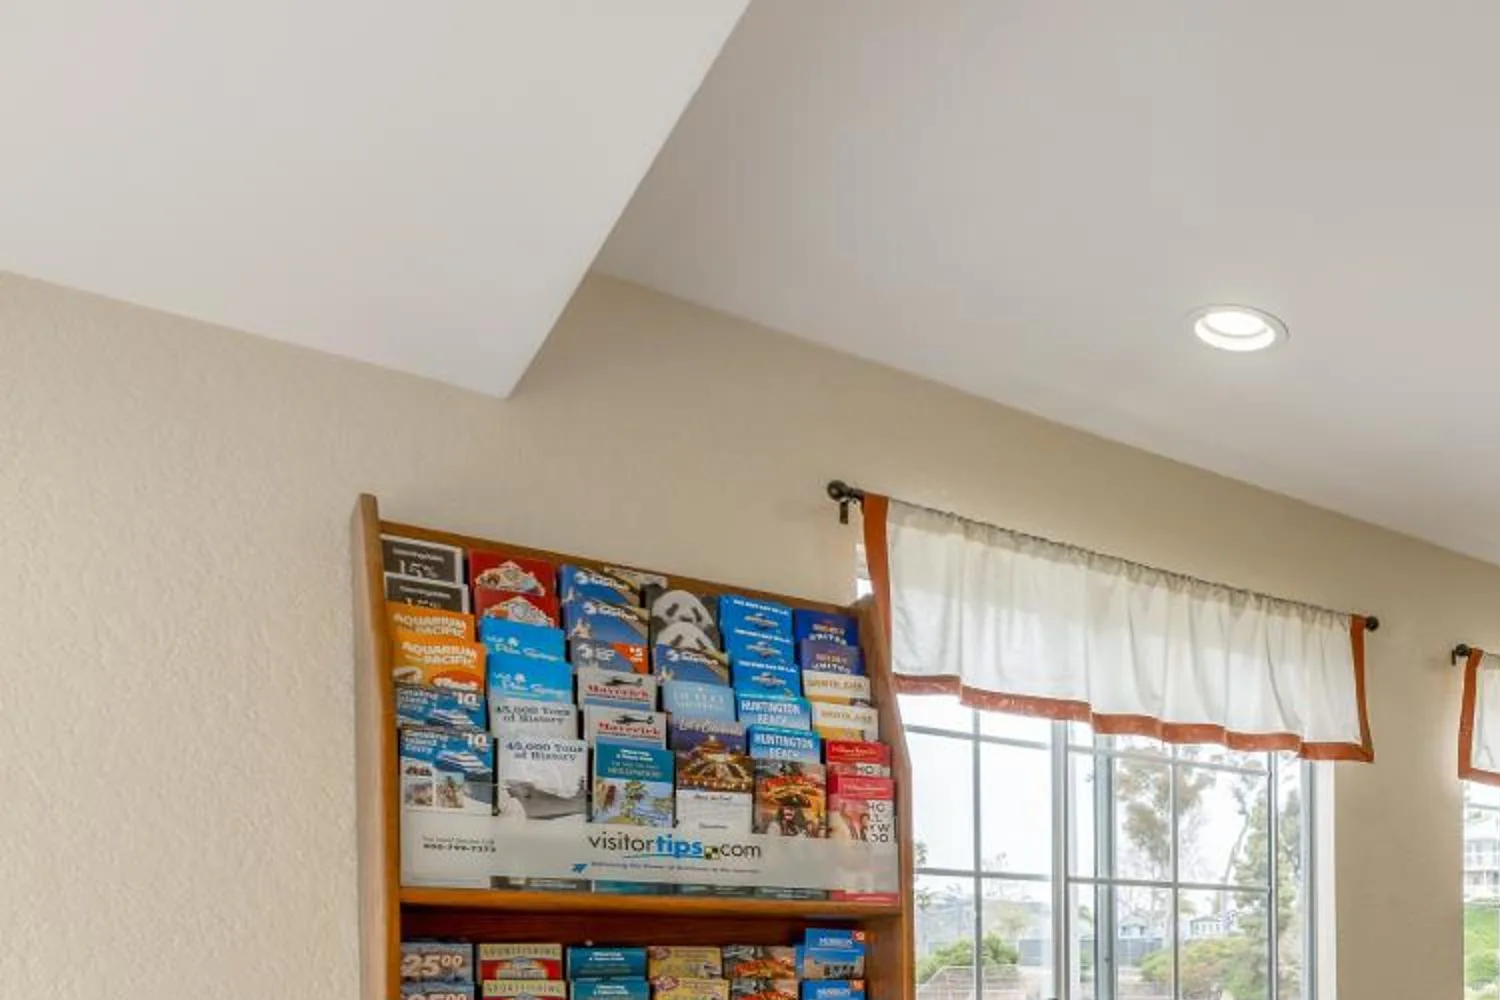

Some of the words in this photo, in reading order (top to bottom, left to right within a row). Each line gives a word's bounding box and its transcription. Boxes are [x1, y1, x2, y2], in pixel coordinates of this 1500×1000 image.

[401, 642, 478, 660] AQUARIUM
[599, 721, 661, 738] Maverick
[530, 752, 577, 762] History
